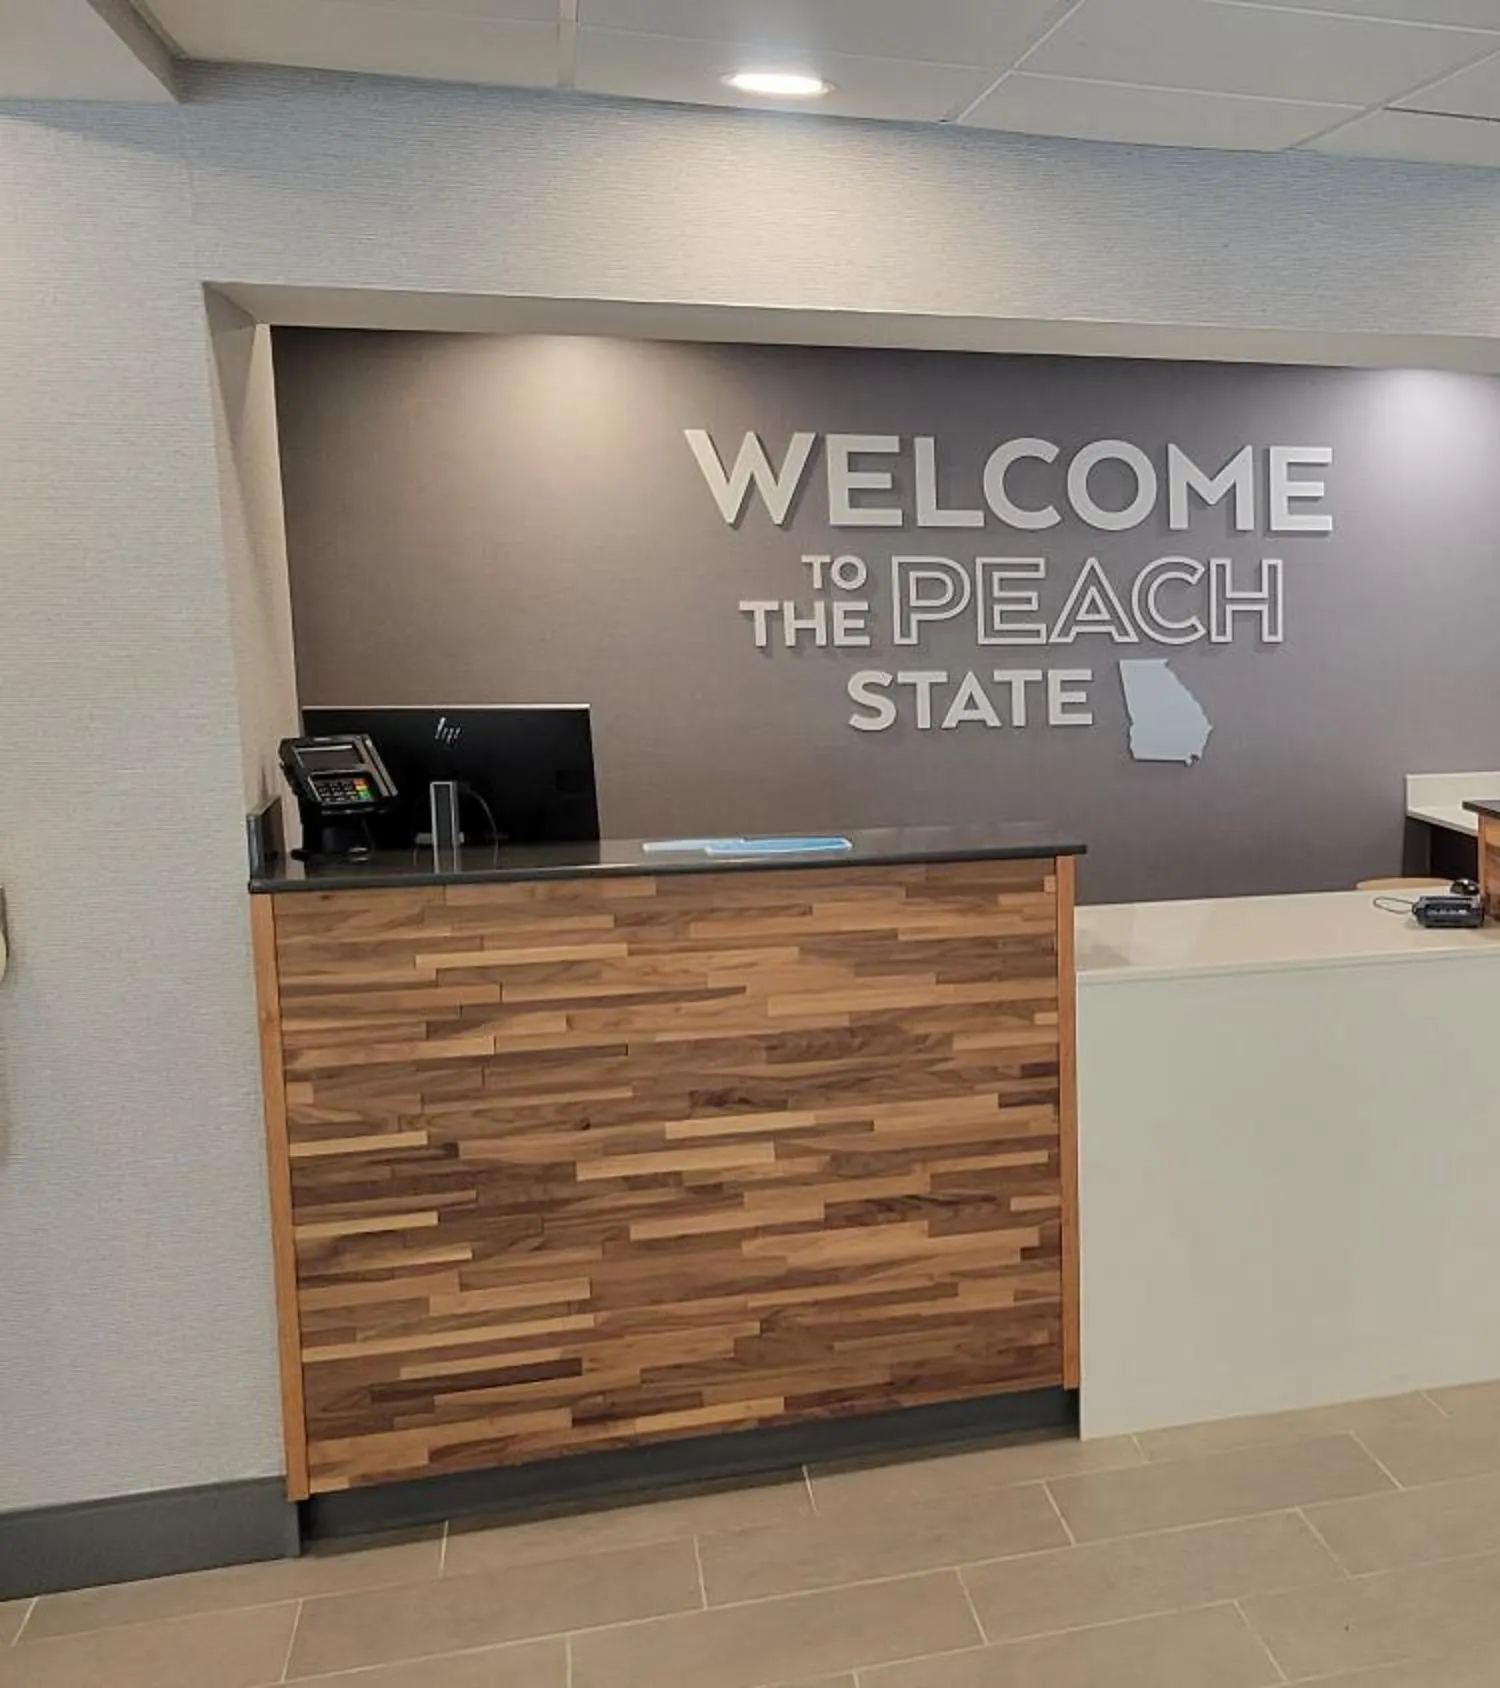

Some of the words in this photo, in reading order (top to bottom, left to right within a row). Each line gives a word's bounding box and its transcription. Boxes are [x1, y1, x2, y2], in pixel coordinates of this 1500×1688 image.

[683, 428, 1333, 531] WELCOME
[801, 554, 867, 591] TO
[891, 555, 1284, 645] PEACH
[738, 600, 871, 648] THE
[847, 669, 1093, 731] STATE
